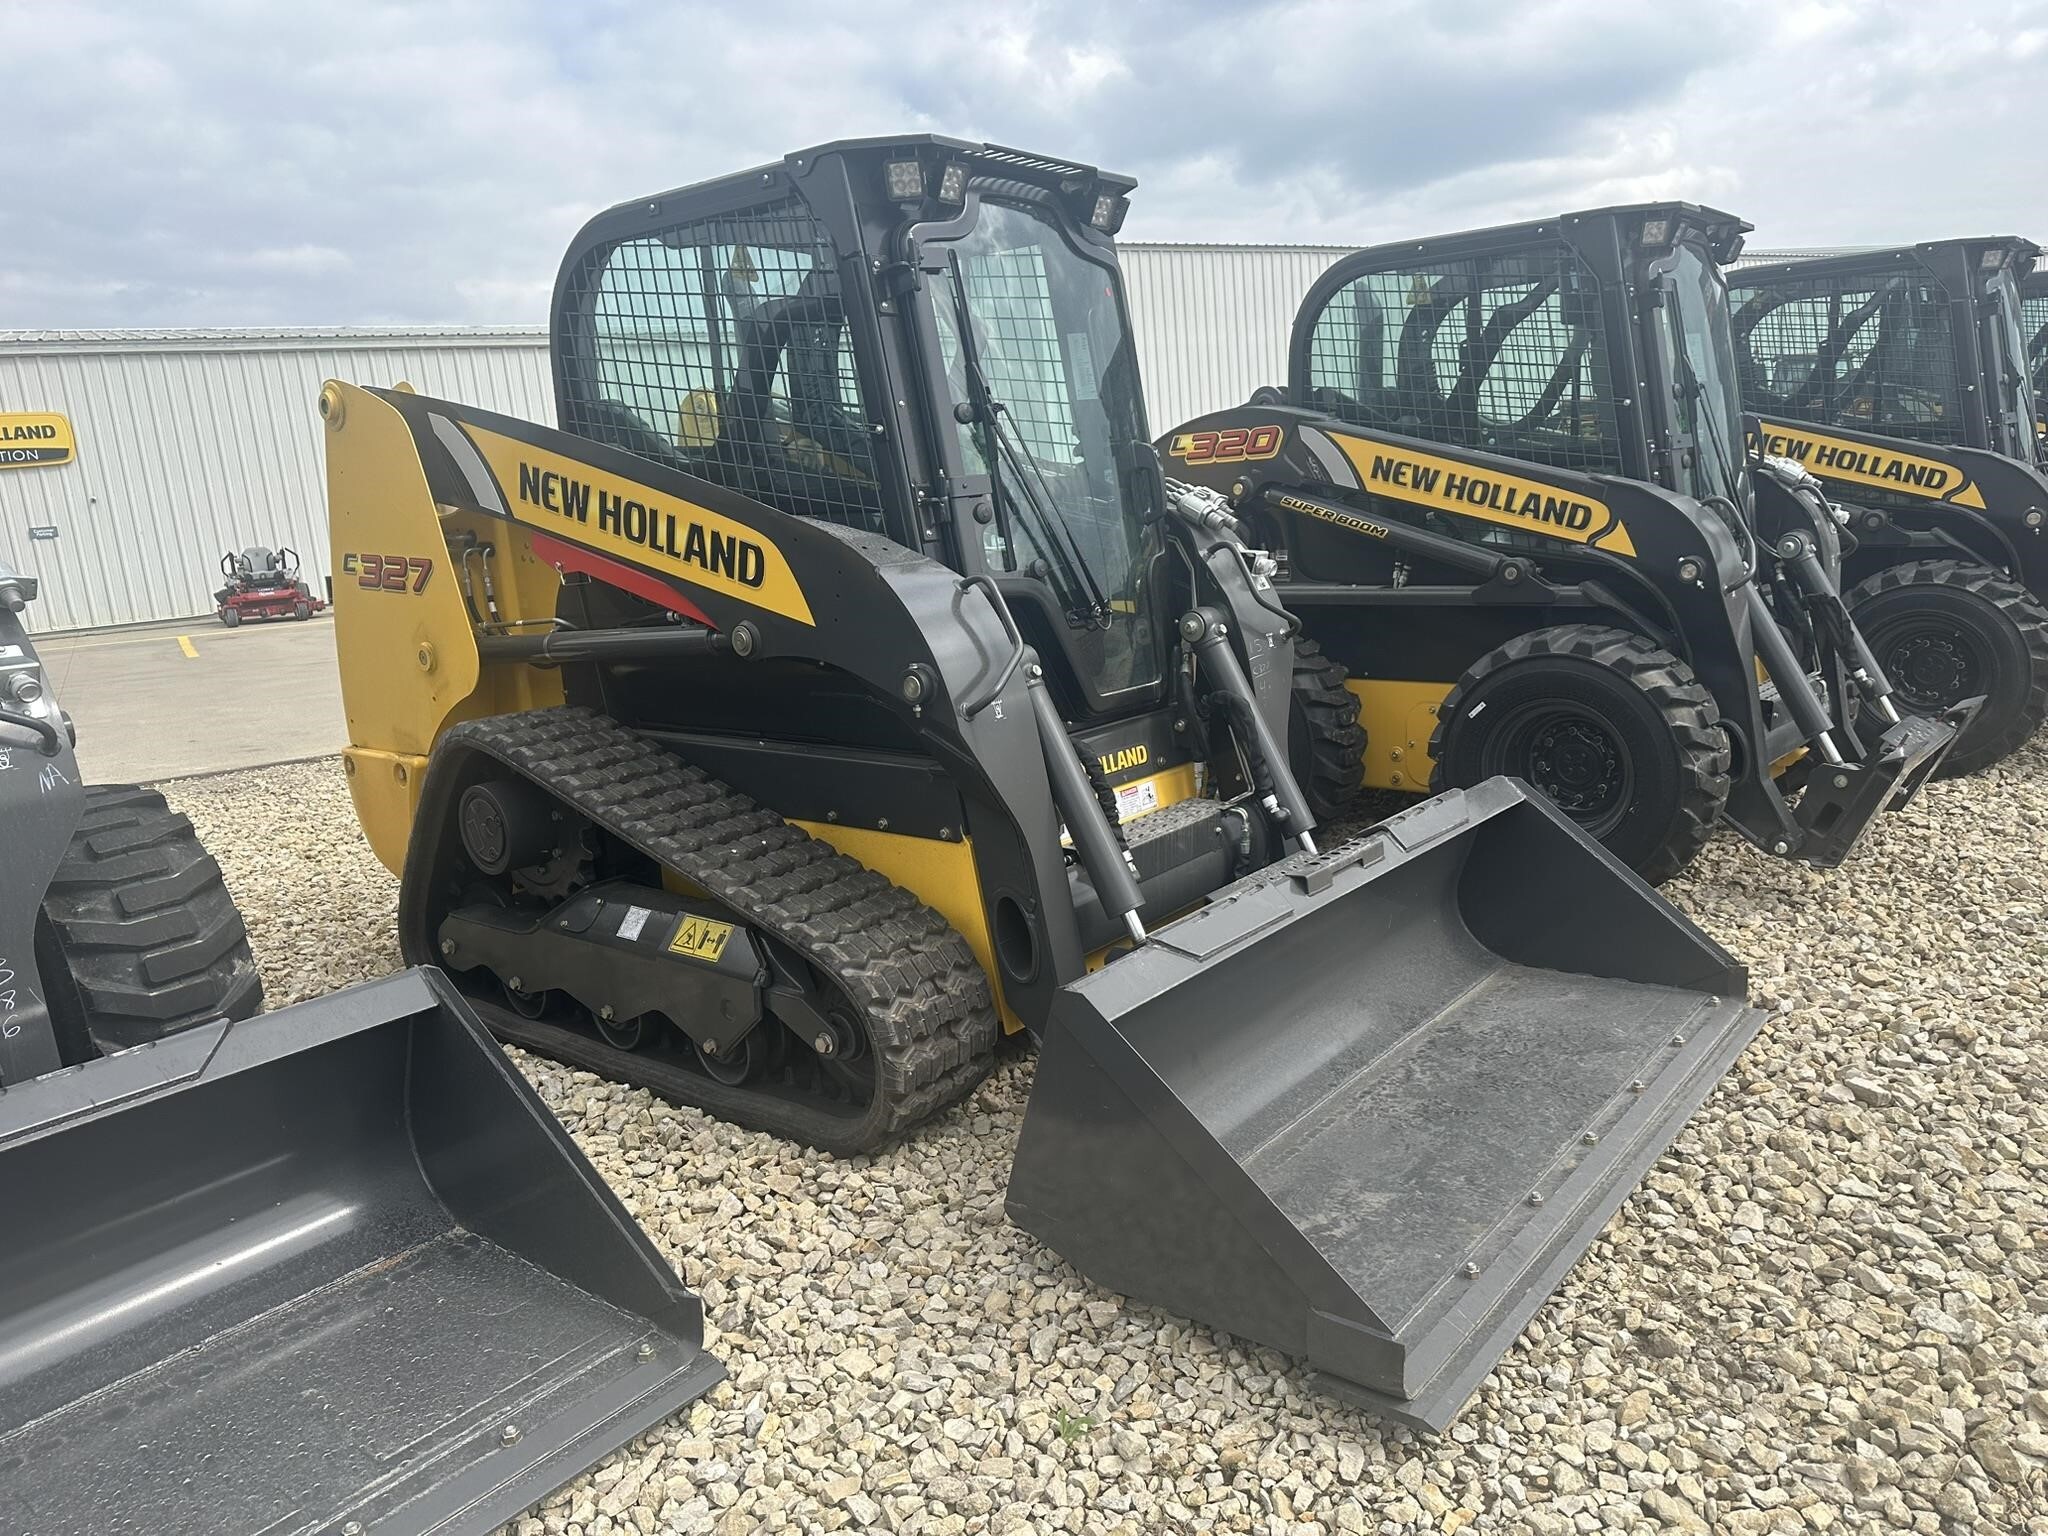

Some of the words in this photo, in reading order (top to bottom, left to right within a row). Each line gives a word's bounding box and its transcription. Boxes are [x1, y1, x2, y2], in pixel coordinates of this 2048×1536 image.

[0, 425, 56, 441] LAND
[1169, 425, 1283, 465] L320
[1815, 444, 1948, 490] HOLLAND
[1370, 455, 1441, 494] NEW
[1443, 472, 1592, 531] HOLLAND
[519, 462, 590, 523] NEW
[599, 488, 765, 590] HOLLAND
[1280, 496, 1337, 522] SUPER
[1335, 514, 1388, 538] BOOM
[343, 553, 434, 595] C327
